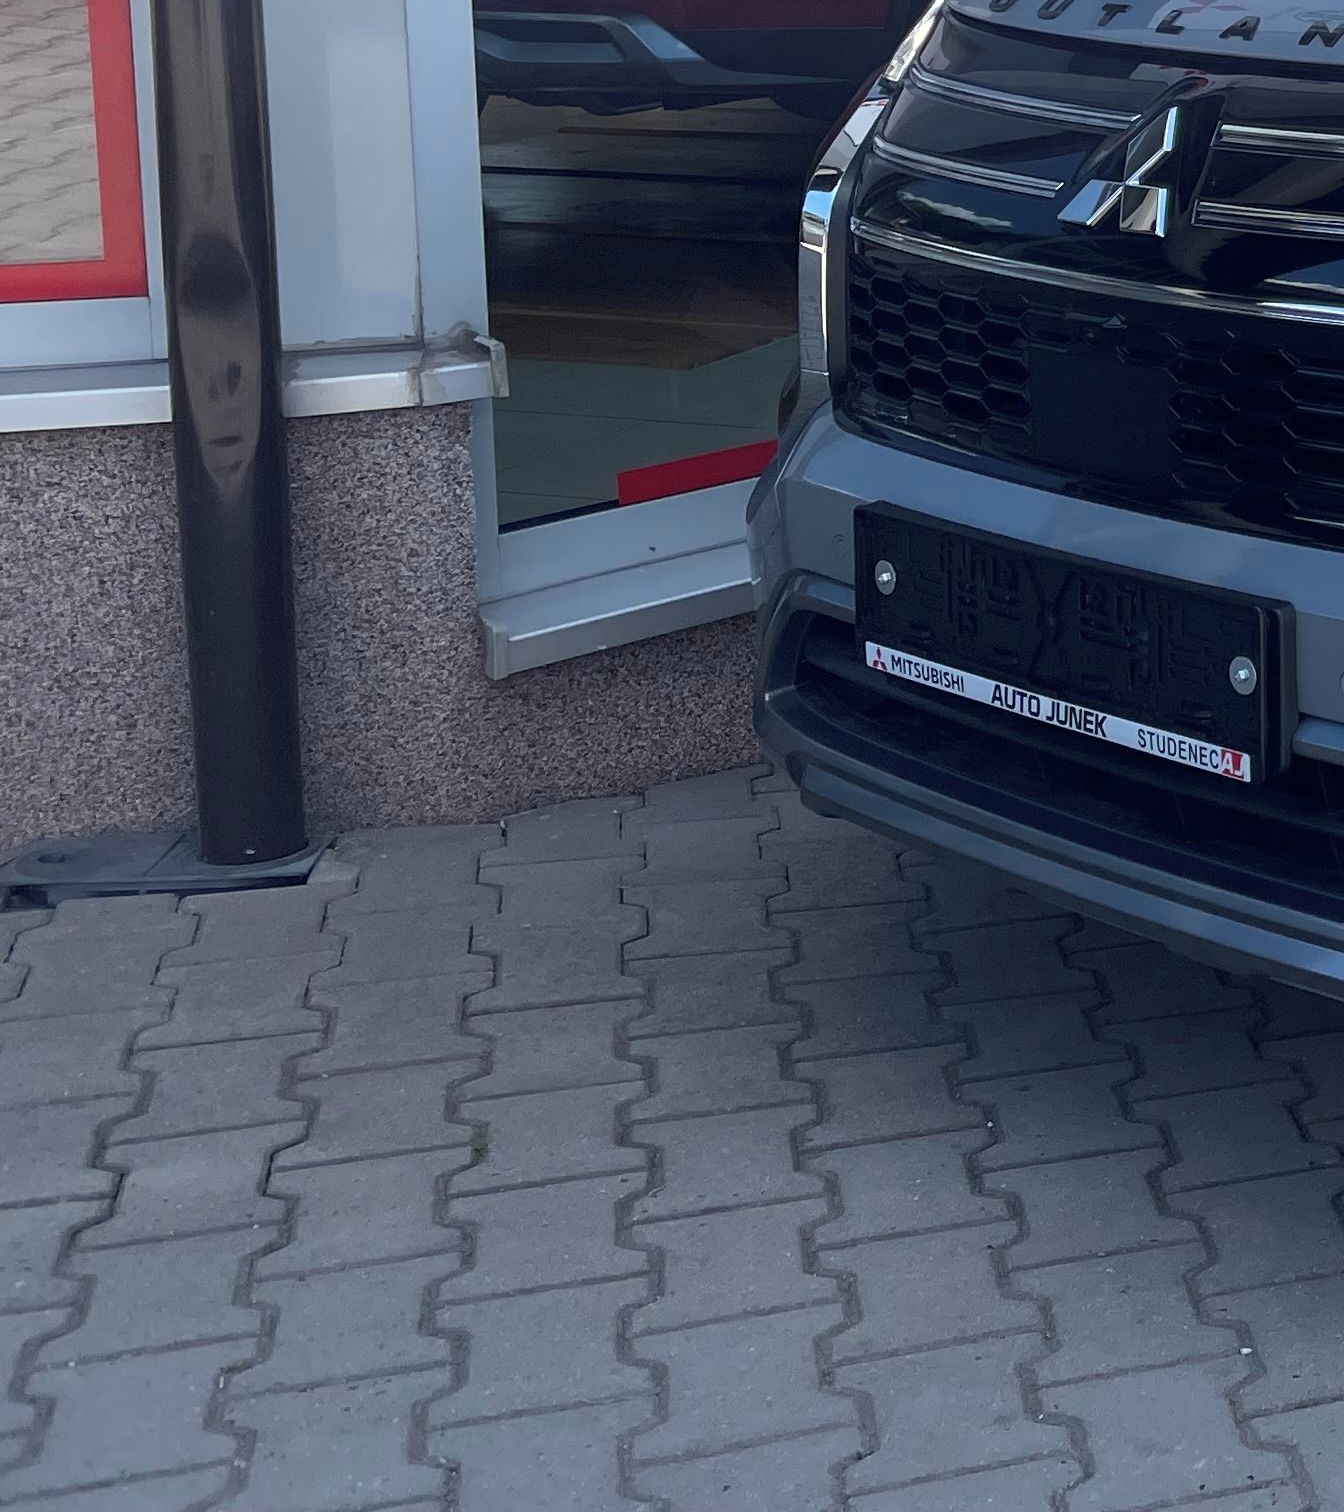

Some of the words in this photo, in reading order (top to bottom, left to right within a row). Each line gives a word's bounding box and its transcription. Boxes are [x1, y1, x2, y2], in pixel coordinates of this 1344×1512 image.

[890, 654, 965, 693] MITSUBISHI
[991, 683, 1041, 718] AUTO
[1046, 700, 1107, 738] JUNEK
[1137, 728, 1219, 769] STUDENEC
